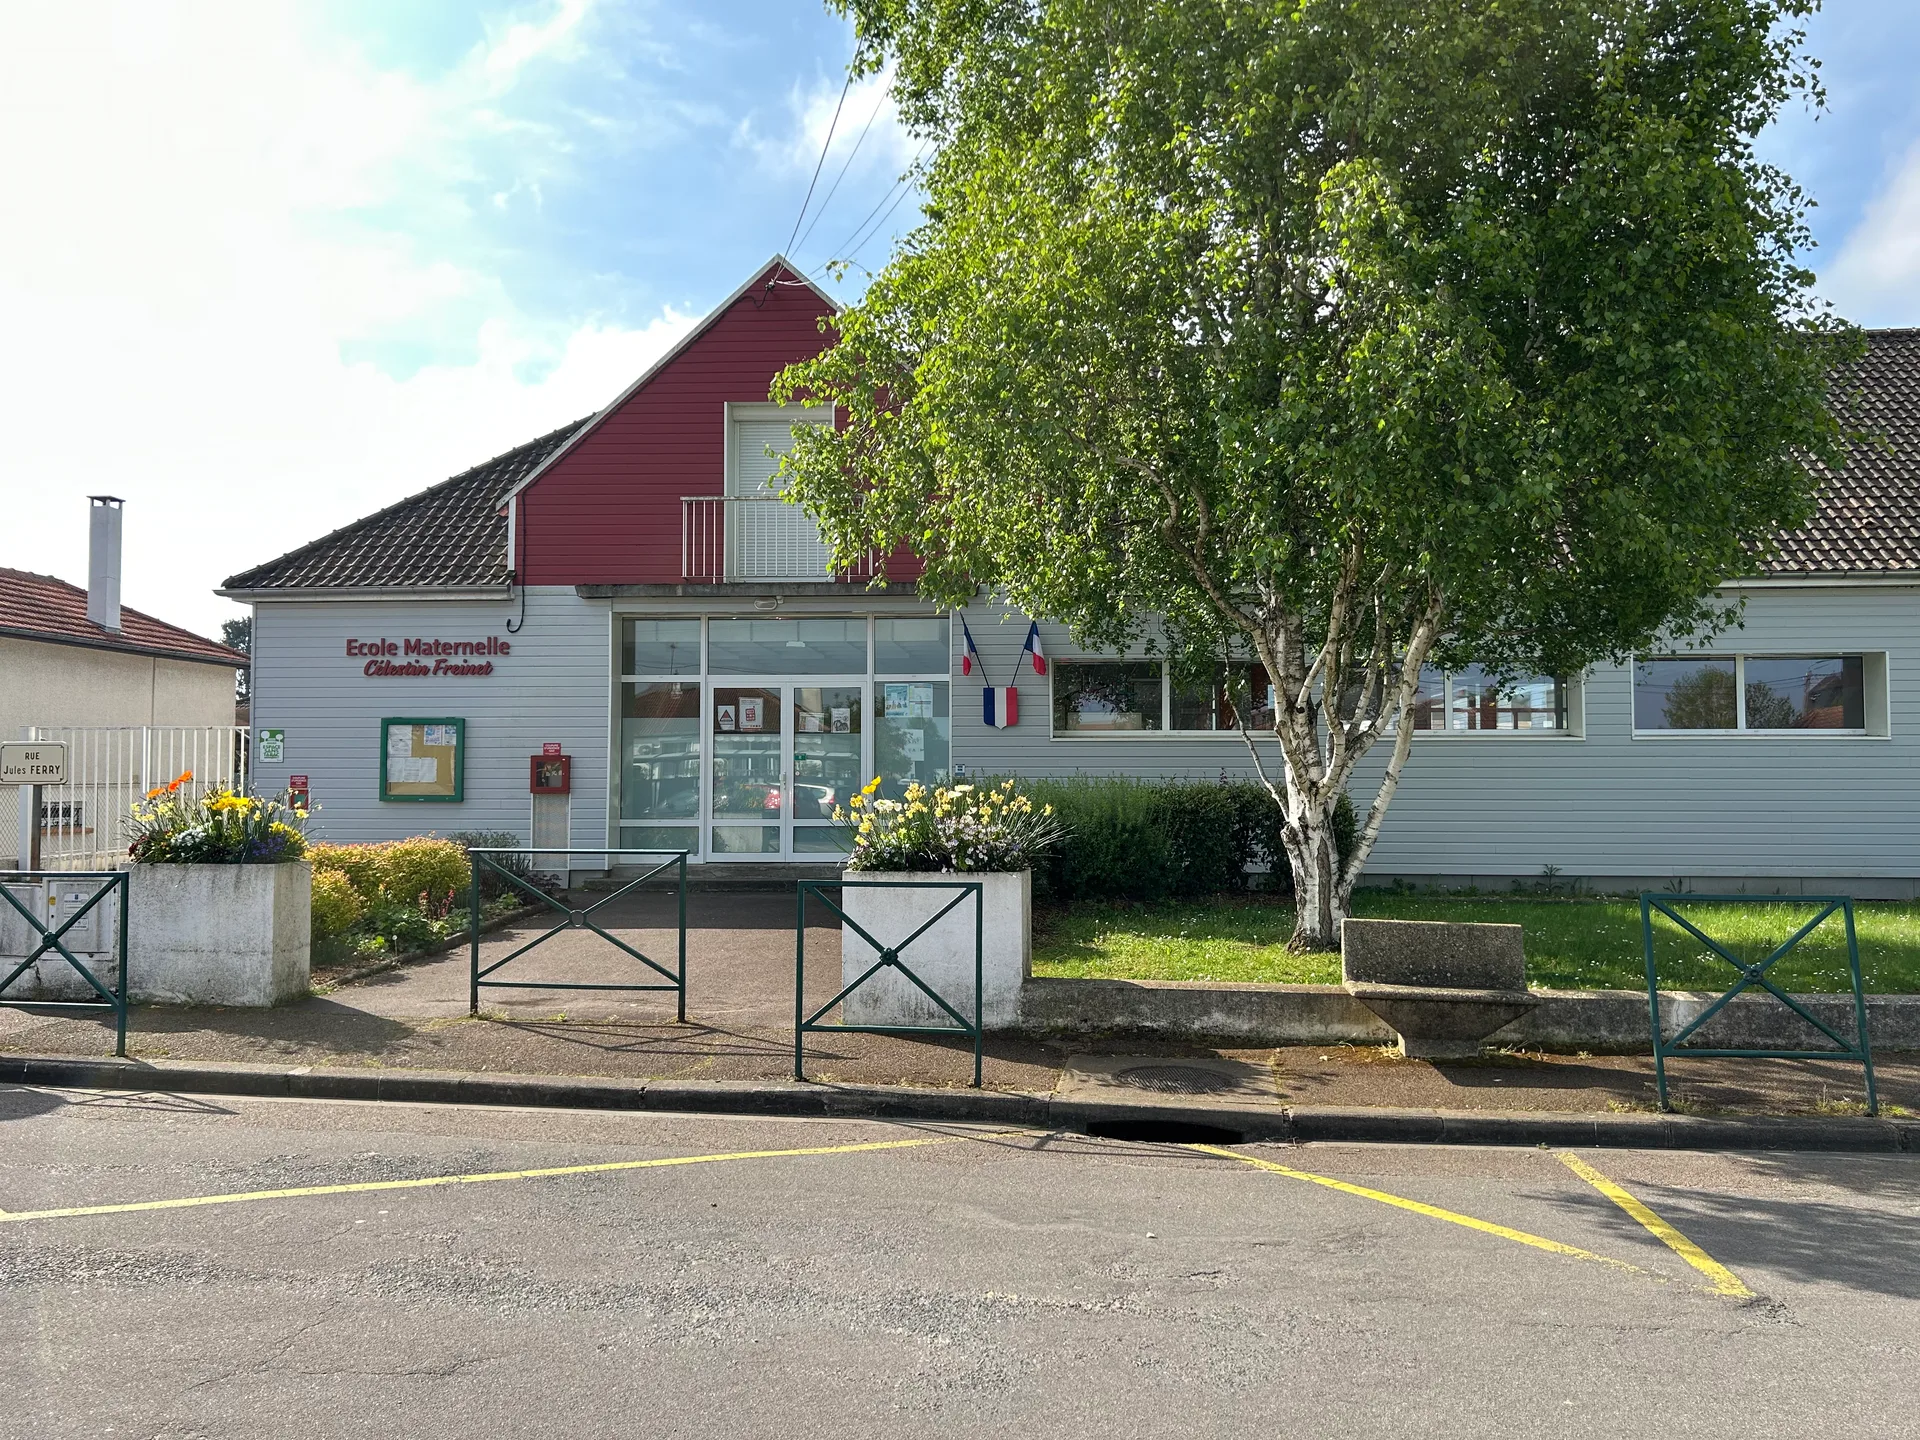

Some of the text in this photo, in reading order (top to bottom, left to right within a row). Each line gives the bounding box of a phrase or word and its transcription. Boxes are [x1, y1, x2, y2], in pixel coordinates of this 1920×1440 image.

[346, 636, 511, 656] Ecole Maternelle
[363, 658, 493, 676] Célestin Freinet
[25, 752, 40, 760] RUE
[3, 765, 60, 775] Jules FERRY
